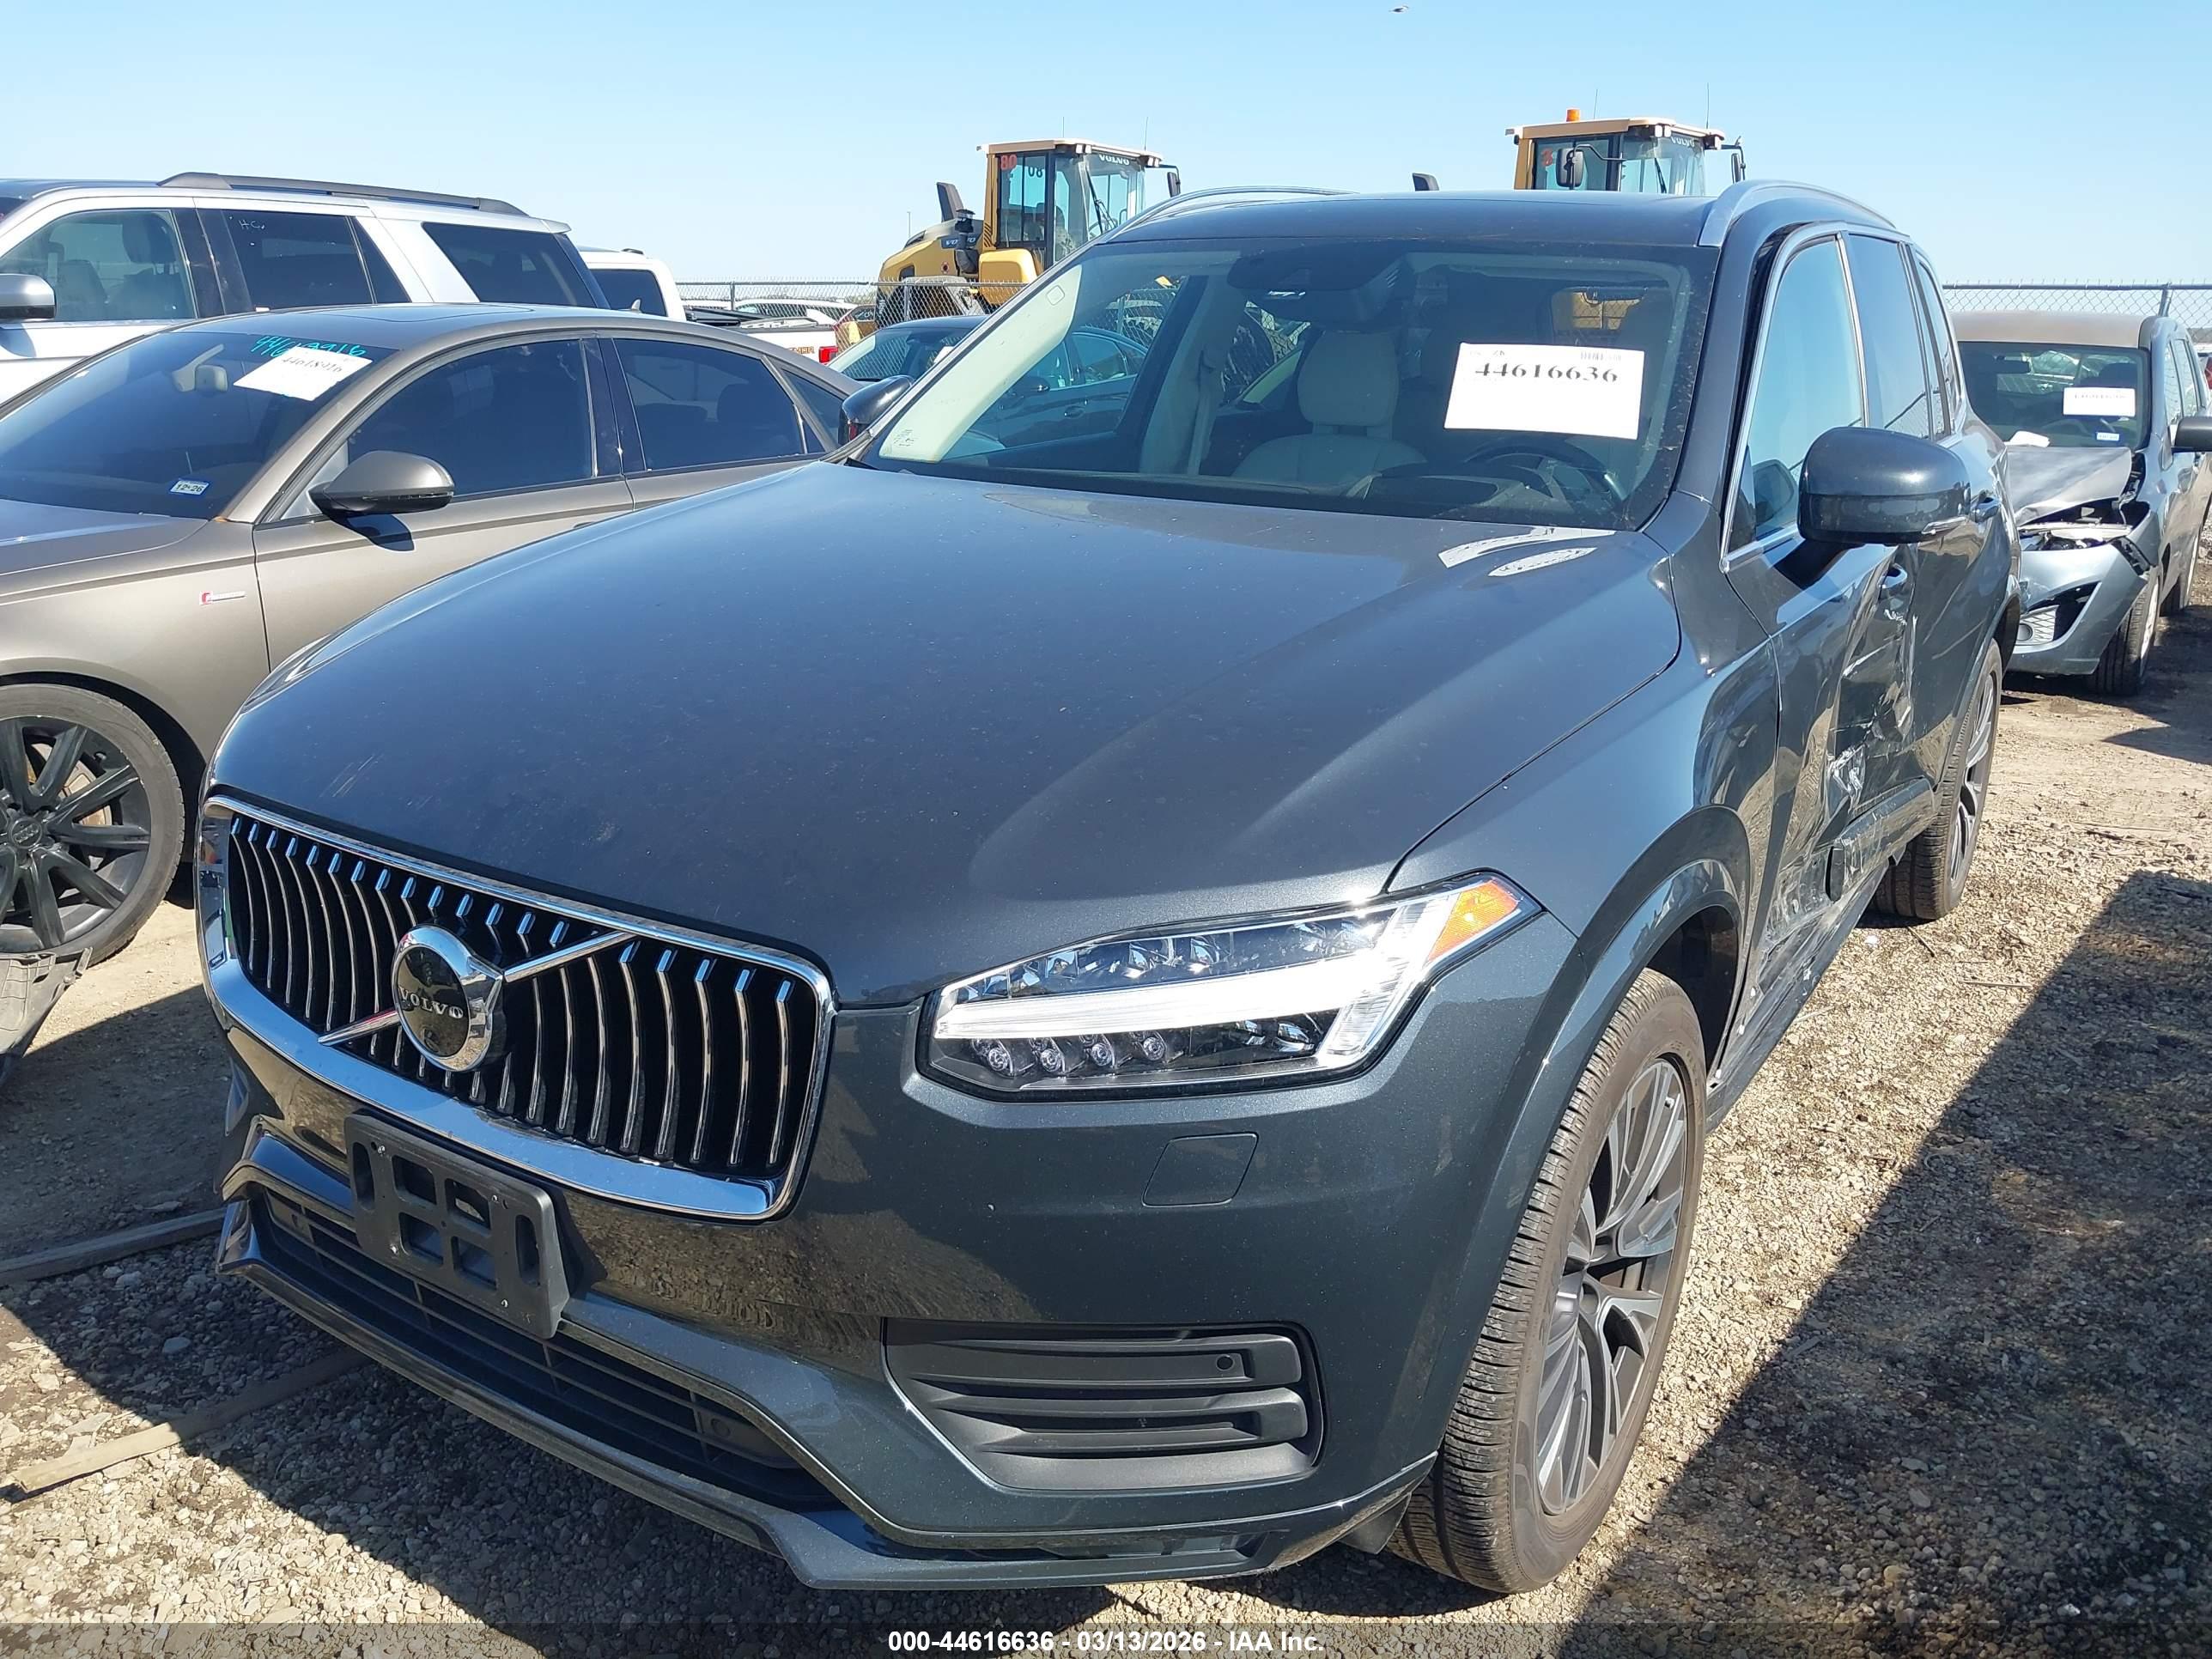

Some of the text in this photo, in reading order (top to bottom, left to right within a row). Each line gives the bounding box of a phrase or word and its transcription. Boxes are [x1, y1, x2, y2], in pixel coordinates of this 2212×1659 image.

[1670, 137, 1695, 147] VOLVO
[1000, 155, 1018, 170] 80
[1098, 154, 1130, 166] VOLVO
[1474, 362, 1619, 383] 44616636
[398, 986, 464, 1018] VOLVO
